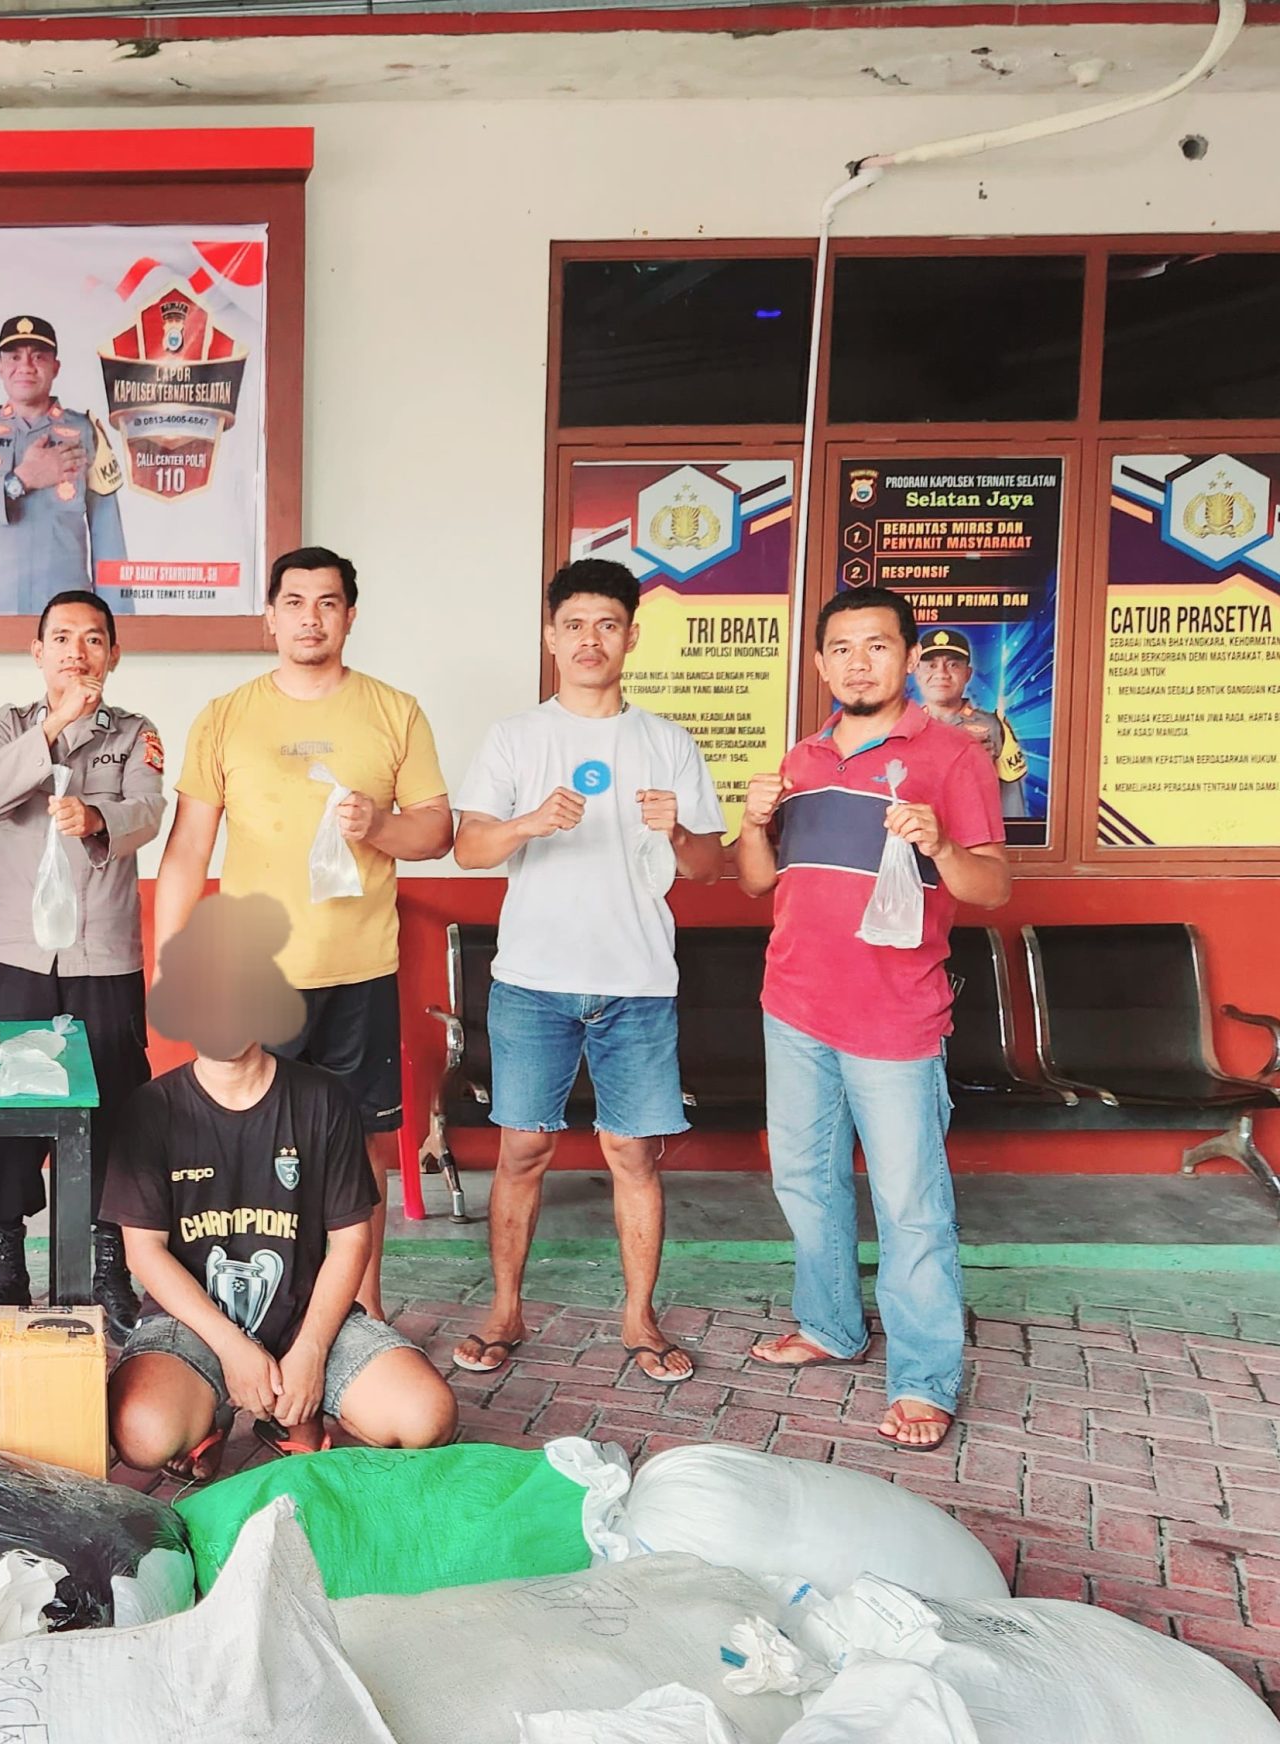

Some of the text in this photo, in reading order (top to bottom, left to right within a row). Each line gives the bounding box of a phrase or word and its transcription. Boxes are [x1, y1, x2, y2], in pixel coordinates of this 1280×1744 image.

[156, 367, 191, 382] LAPOR
[114, 380, 232, 404] KAPOLSEK TERNATE SELATAN
[137, 453, 155, 467] CALL
[155, 454, 185, 466] CENTER
[156, 468, 185, 493] 110
[886, 475, 1056, 488] PROGRAM KAPOLSEK TERNATE SELATAN
[906, 491, 1034, 509] Selatan Jaya
[883, 522, 948, 535] BERANTAS
[952, 522, 993, 535] MIRAS
[998, 522, 1023, 535] DAN
[883, 536, 1032, 549] PENYAKIT MASYARAKAT
[882, 566, 950, 579] RESPONSIF
[120, 589, 216, 599] KAPOLSEK TERNATE SELATAN
[957, 594, 999, 607] PRIMA
[1003, 594, 1029, 607] DAN
[1111, 605, 1272, 634] CATUR PRASETYA
[686, 617, 780, 644] TRI BRATA
[681, 647, 779, 658] KAMI POLISI INDONESIA
[1189, 652, 1208, 661] DEMI
[585, 769, 600, 786] S
[172, 1167, 215, 1182] erspo
